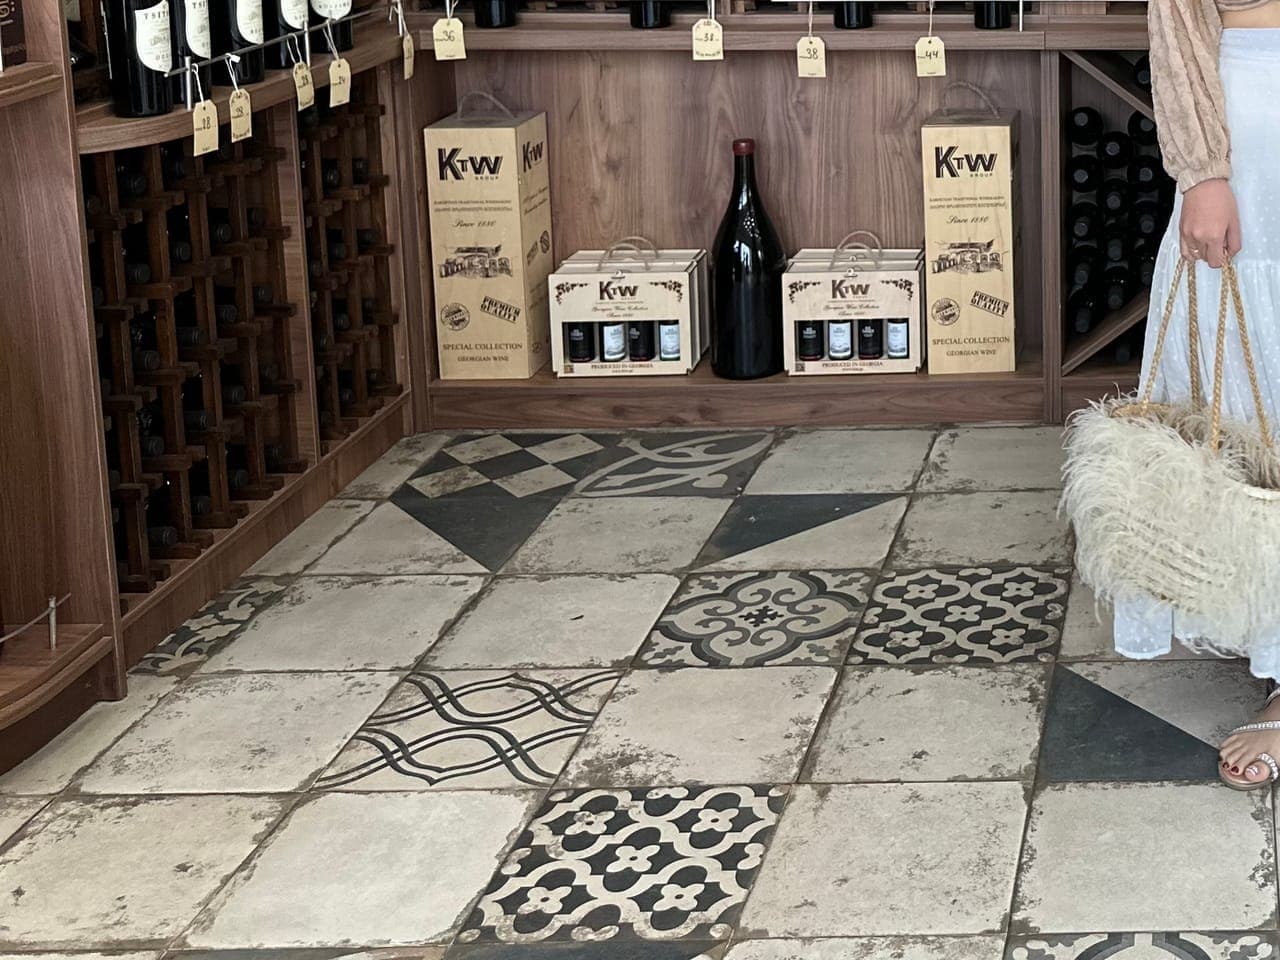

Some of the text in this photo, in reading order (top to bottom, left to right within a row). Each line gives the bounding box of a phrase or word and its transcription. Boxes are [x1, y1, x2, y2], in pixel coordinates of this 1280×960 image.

[443, 30, 455, 42] 36
[806, 48, 818, 60] 38
[925, 50, 938, 60] 44
[438, 147, 504, 181] KTW
[522, 141, 544, 173] KTW
[935, 145, 998, 179] KTW
[599, 280, 639, 300] KTW
[831, 279, 871, 299] KTW
[443, 342, 523, 351] SPECIAL COLLECTION
[932, 336, 1010, 346] SPECIAL COLLECTION
